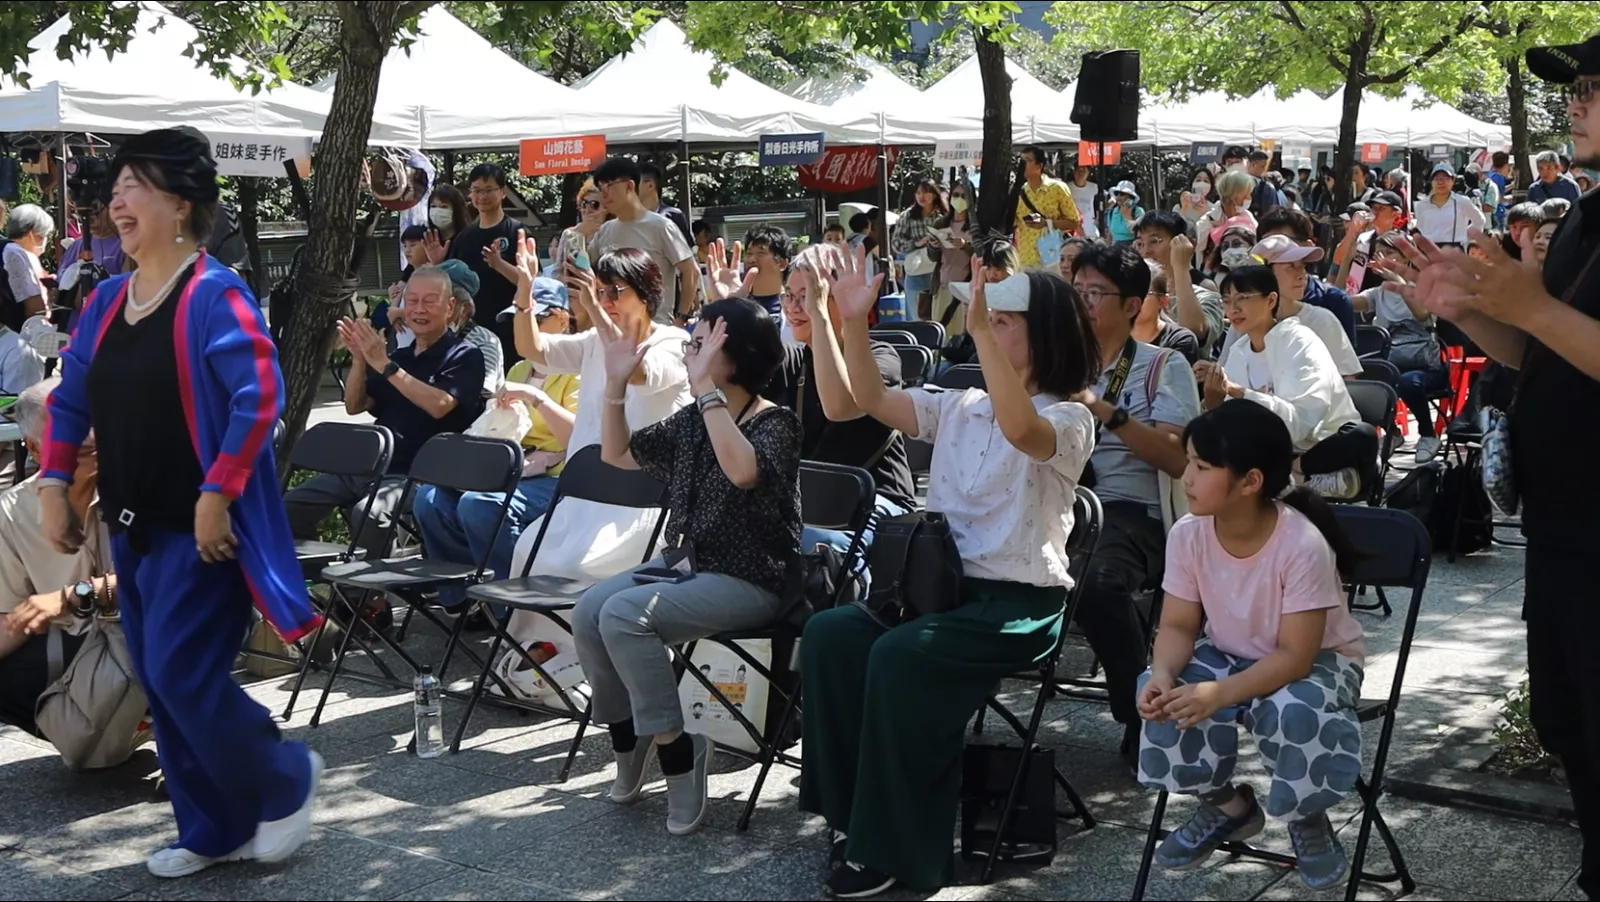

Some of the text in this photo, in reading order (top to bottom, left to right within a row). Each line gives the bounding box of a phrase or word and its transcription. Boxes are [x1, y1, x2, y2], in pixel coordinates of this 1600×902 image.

[215, 142, 287, 162] 姐妹愛手作
[543, 139, 584, 156] 山姆花藝
